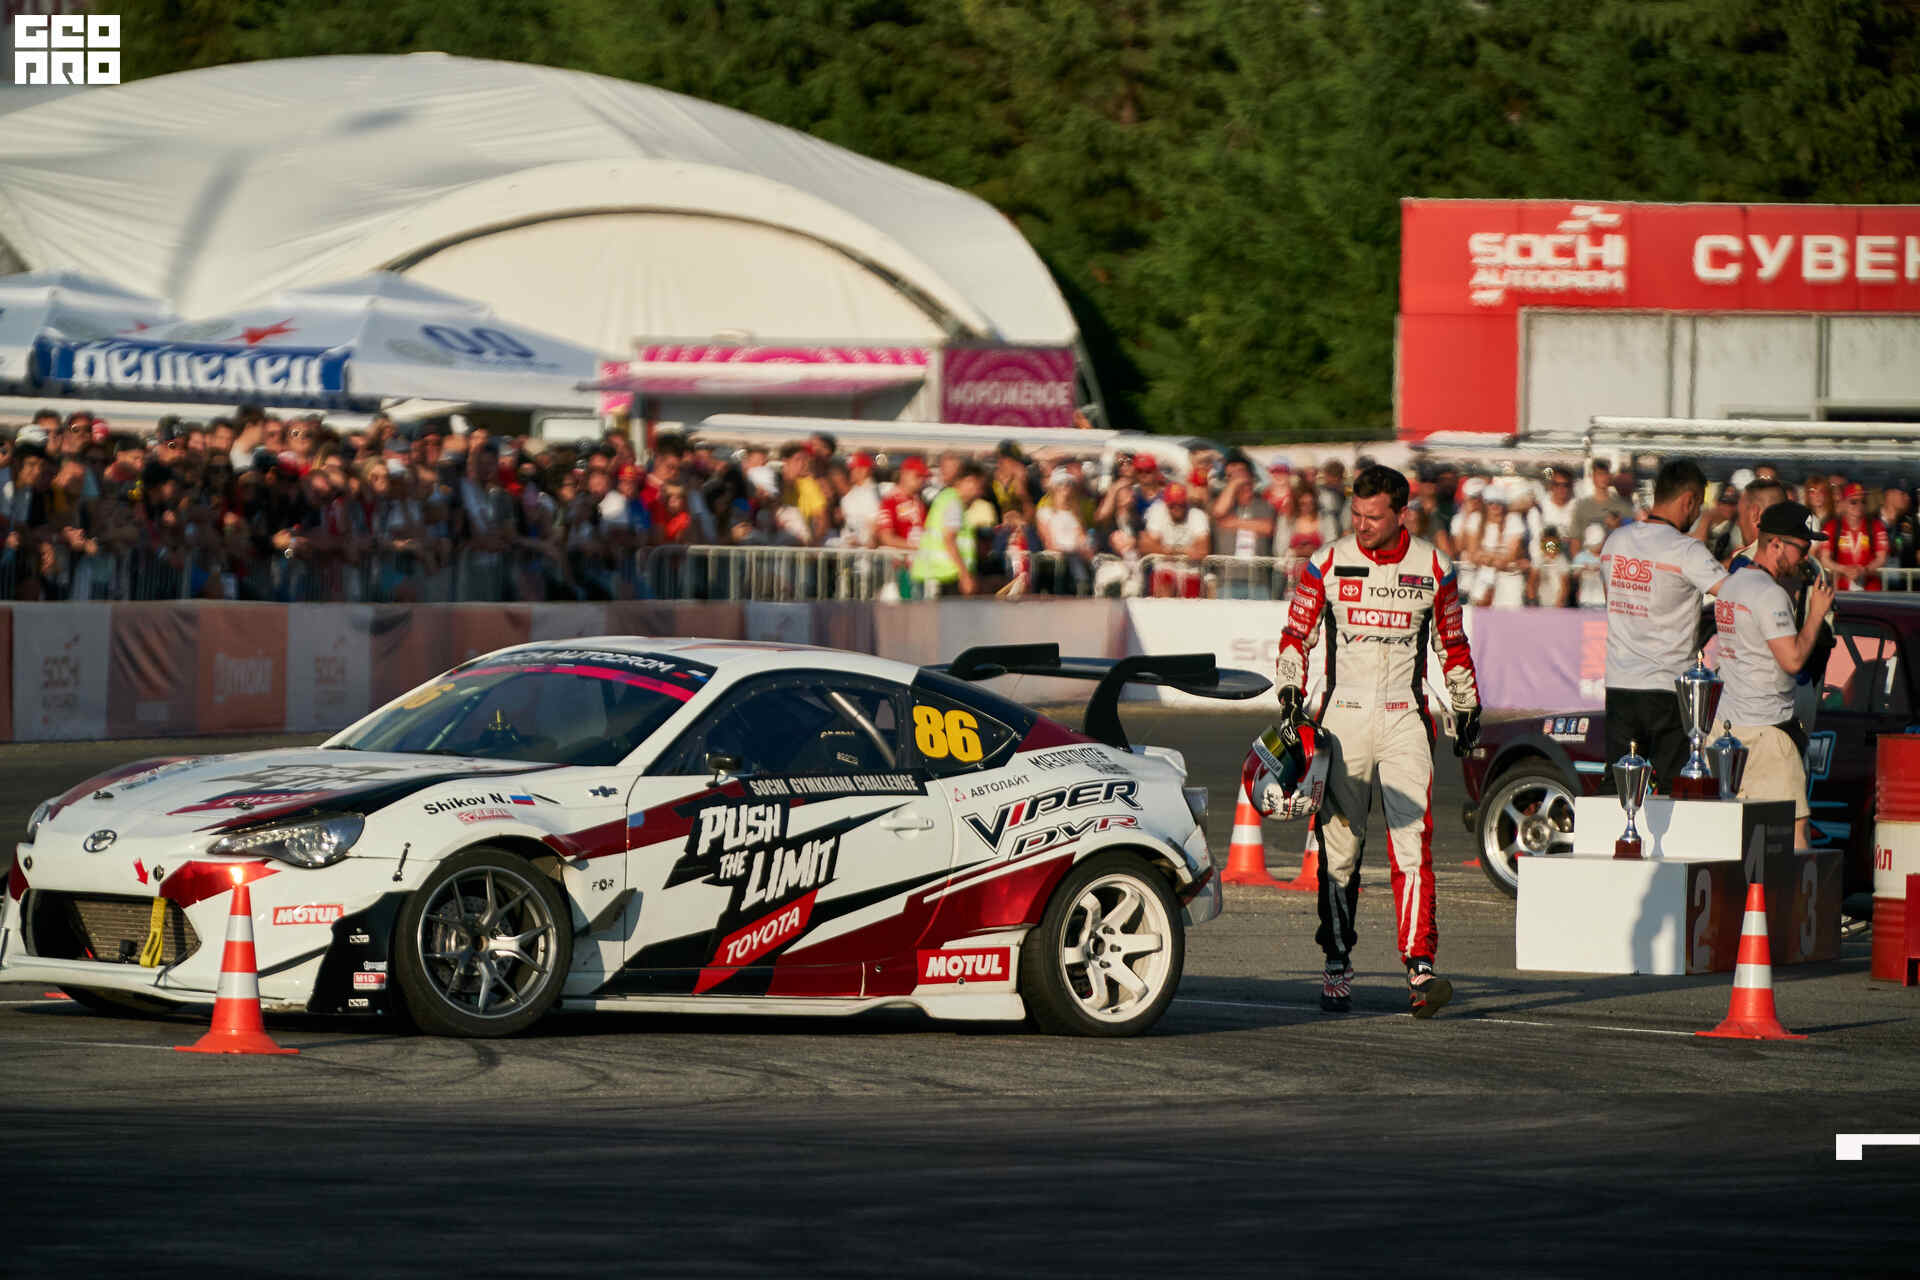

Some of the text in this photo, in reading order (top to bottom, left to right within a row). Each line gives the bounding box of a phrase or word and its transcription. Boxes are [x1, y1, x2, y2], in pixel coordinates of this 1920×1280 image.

[1469, 233, 1625, 267] SOCHI
[1369, 587, 1423, 600] TOYOTA
[1350, 609, 1408, 627] MOTUL
[1342, 632, 1415, 647] VIPER
[555, 650, 676, 673] AUTODROM
[912, 705, 984, 762] 86
[749, 774, 919, 796] SOCHI GYMKHANA CHALLENGE
[970, 774, 1031, 798] АВТОЛАЙТ
[424, 792, 511, 815] Shikov N.
[962, 778, 1143, 854] VIPER
[696, 802, 782, 856] PUSH
[1009, 815, 1143, 860] DVR
[719, 837, 836, 912] THE LIMIT
[275, 906, 339, 924] MOTUL
[1694, 868, 1712, 971] 2
[1801, 861, 1817, 956] 3
[726, 906, 800, 964] TOYOTA
[926, 954, 1003, 978] MOTUL
